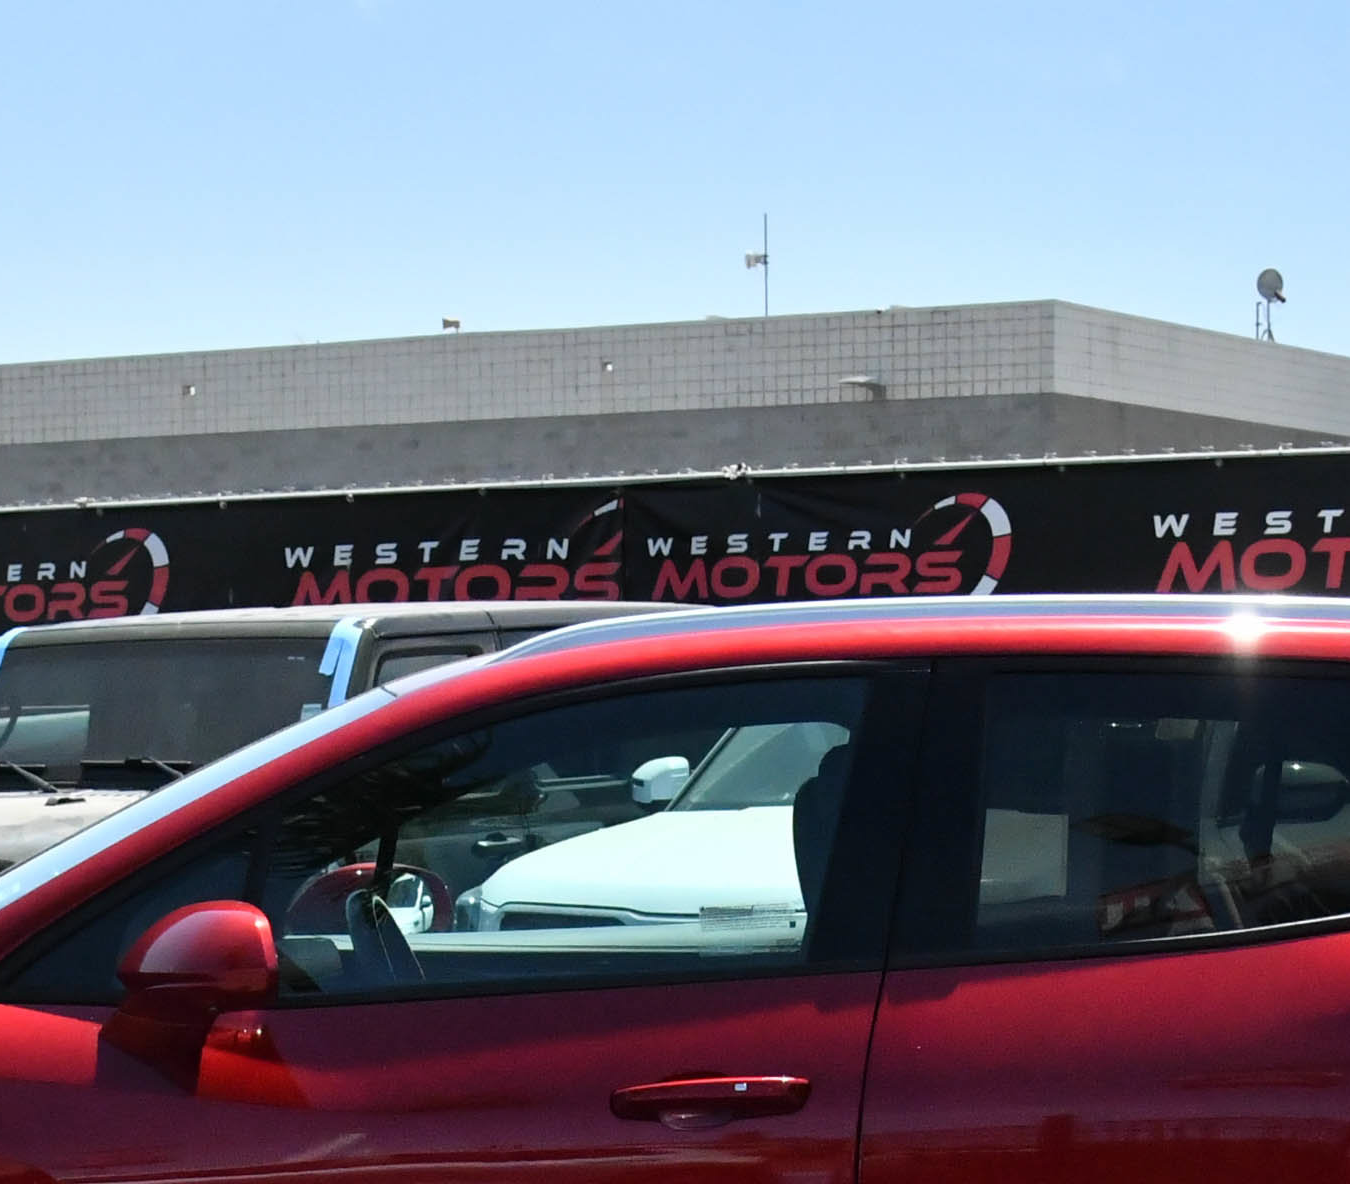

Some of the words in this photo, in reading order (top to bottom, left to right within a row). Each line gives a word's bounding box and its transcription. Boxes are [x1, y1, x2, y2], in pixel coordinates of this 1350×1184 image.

[284, 538, 570, 568] WESTERN
[647, 528, 912, 557] WESTERN
[291, 562, 622, 606] MOTORS
[652, 551, 963, 600] MOTORS
